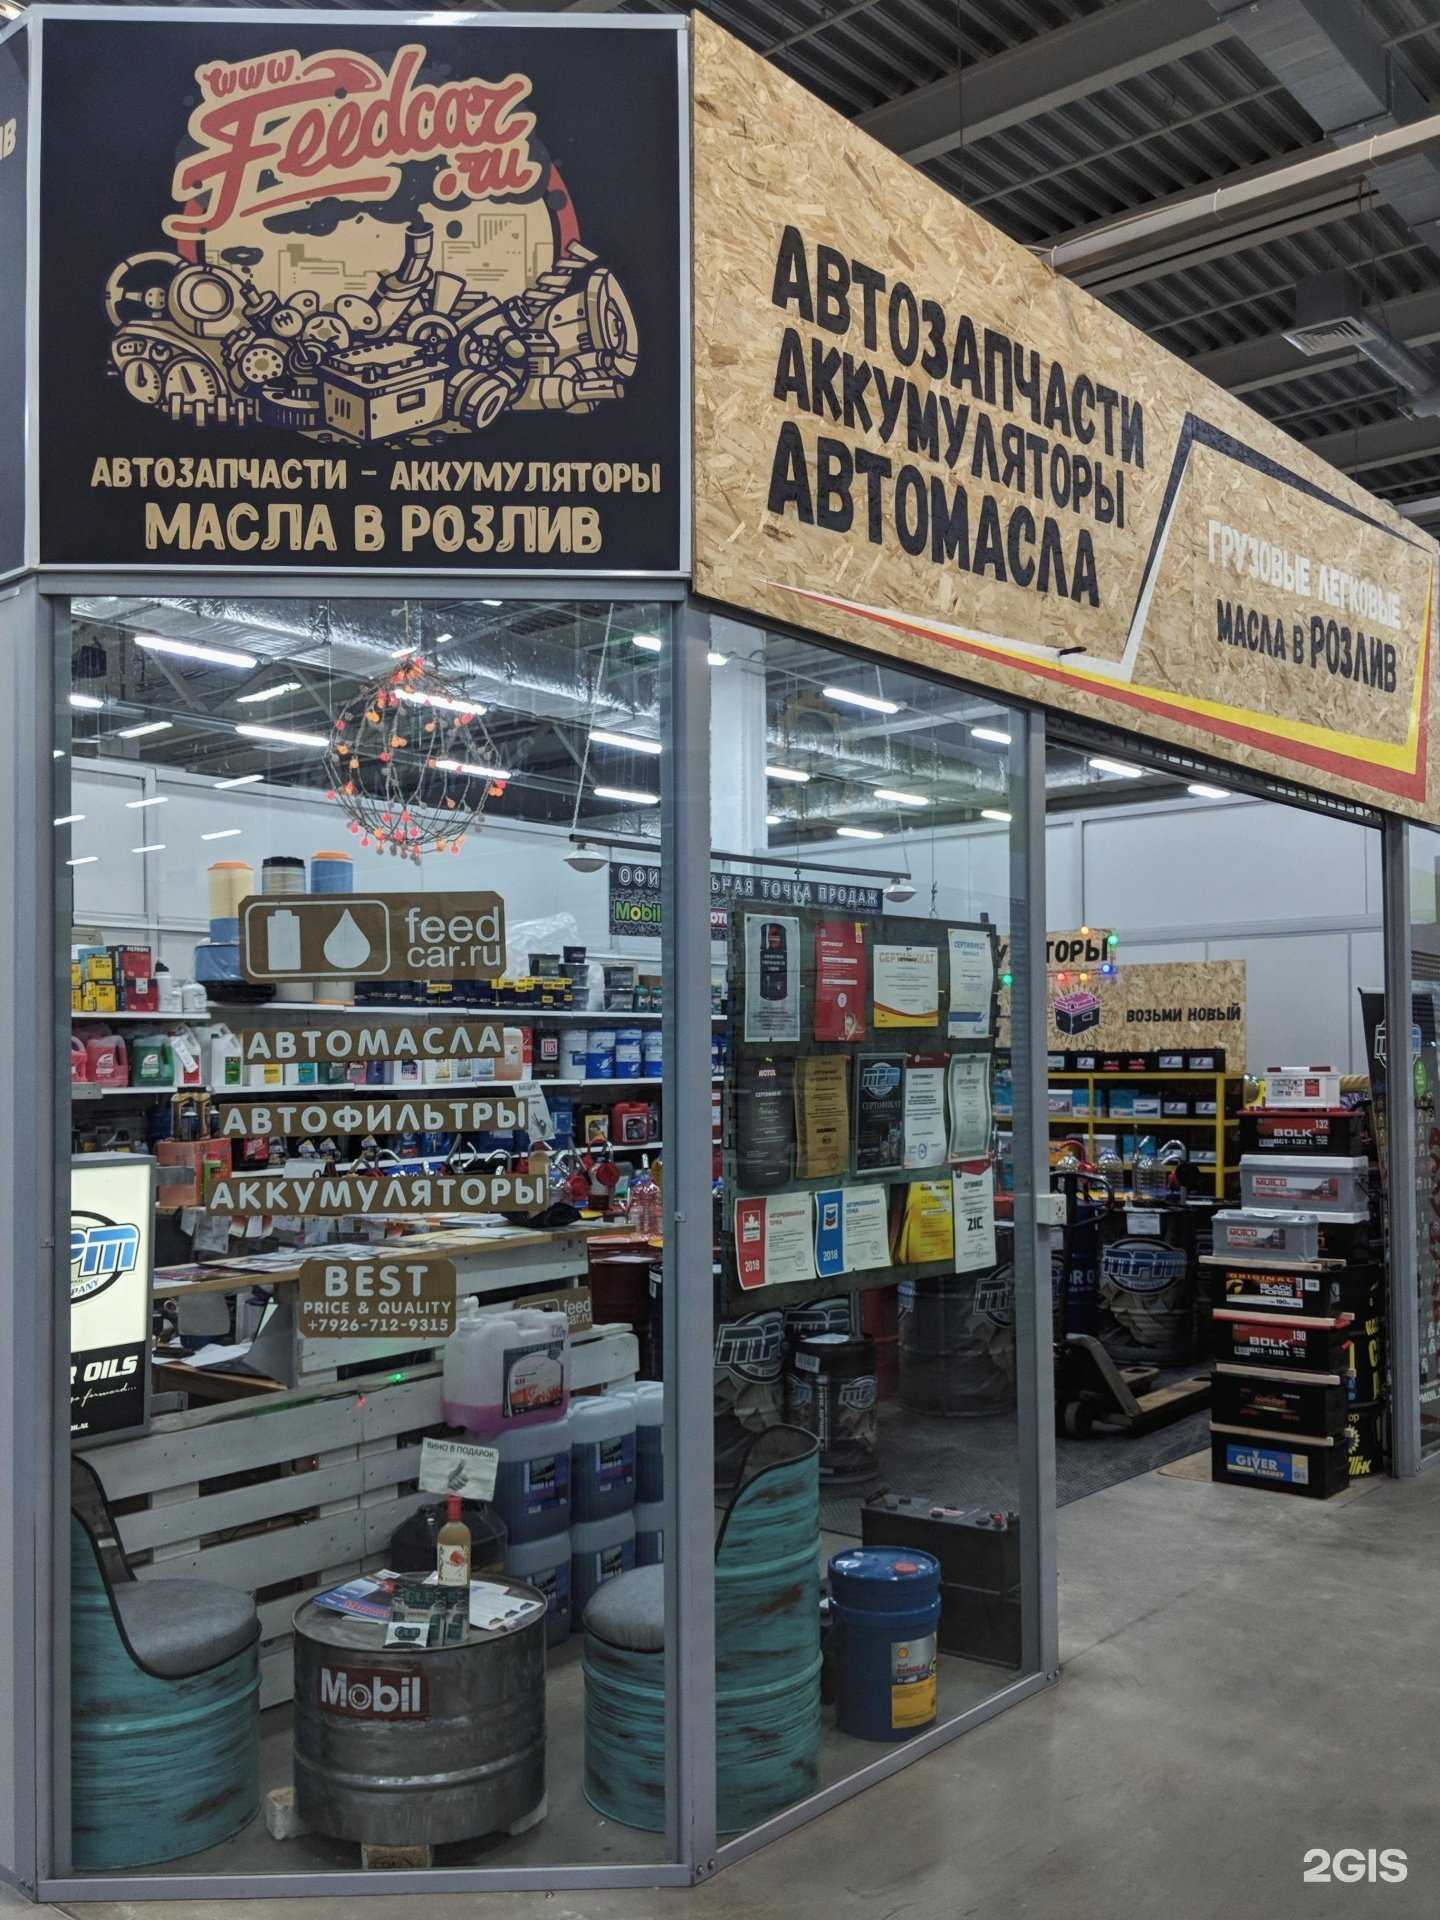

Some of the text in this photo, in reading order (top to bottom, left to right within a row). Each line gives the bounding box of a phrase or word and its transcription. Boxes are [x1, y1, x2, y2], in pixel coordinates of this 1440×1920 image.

[772, 225, 1144, 469] АВТОЗАПЧАСТИ
[773, 328, 1124, 528] АККУМУЛЯТОРЫ
[91, 457, 347, 489] АВТОЗАПЧАСТИ
[390, 461, 661, 493] АККУМУЛЯТОРЫ
[145, 503, 603, 555] МАСЛА В РОЗЛИВ
[767, 422, 1100, 608] АВТОМАСЛА
[1208, 520, 1401, 630] ГРУЗОВЫЕ ЛЕГКОВЫЕ
[1217, 599, 1287, 661] МАСЛА
[1310, 616, 1397, 693] РОЗЛИВ
[762, 879, 811, 902] ТОЧКА
[818, 887, 878, 906] ПРОДАЖ
[404, 905, 500, 944] feed
[614, 900, 662, 923] Mobil
[406, 945, 501, 969] car.ru
[1126, 1003, 1241, 1023] ВОЗЬМИ НОВЫЙ
[247, 1026, 502, 1059] АВТОМАСЛА
[222, 1101, 527, 1136] АВТОФИЛЬТРЫ
[1315, 1119, 1329, 1129] 132
[210, 1176, 545, 1210] АККУМУЛЯТОРЫ
[745, 1259, 760, 1273] 2018
[823, 1249, 839, 1262] 2018
[325, 1265, 429, 1297] BEST
[303, 1301, 452, 1316] PRICE & QUALITY
[563, 1296, 591, 1314] feed
[308, 1318, 449, 1333] +7926-712-9315
[83, 1355, 139, 1383] OILS
[1236, 1450, 1278, 1472] GIVER
[320, 1667, 421, 1713] Mobil
